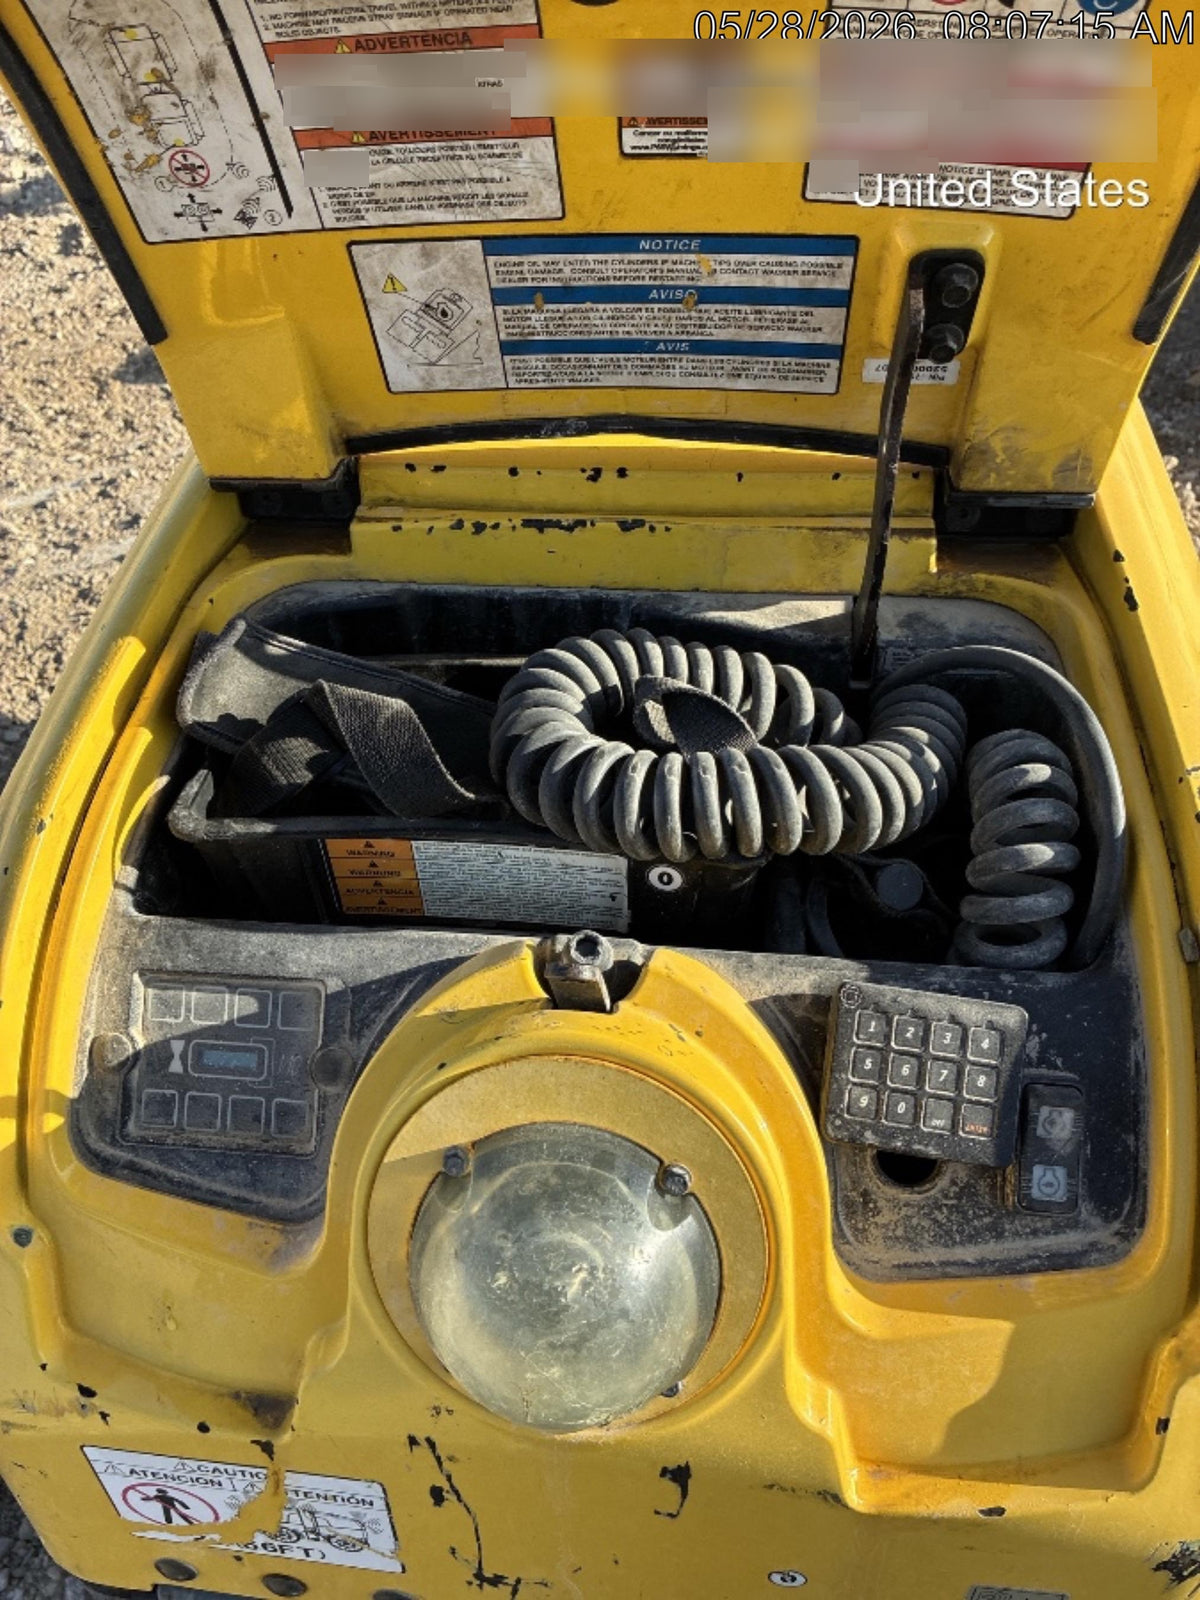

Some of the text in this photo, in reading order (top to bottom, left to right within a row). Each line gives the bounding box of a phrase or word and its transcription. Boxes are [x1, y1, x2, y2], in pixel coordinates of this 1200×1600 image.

[354, 31, 473, 51] ADVERTENCIA
[639, 239, 702, 251] NOTICE
[649, 288, 698, 301] AVISO
[655, 341, 690, 352] AVIS
[868, 1020, 990, 1050] 1 2 3 4
[864, 1058, 986, 1088] 5 6 7 8
[858, 1094, 870, 1108] 9
[897, 1101, 906, 1114] 0
[129, 1467, 223, 1487] ATENCION
[196, 1464, 269, 1480] CAUTIO
[284, 1488, 374, 1507] TENTION
